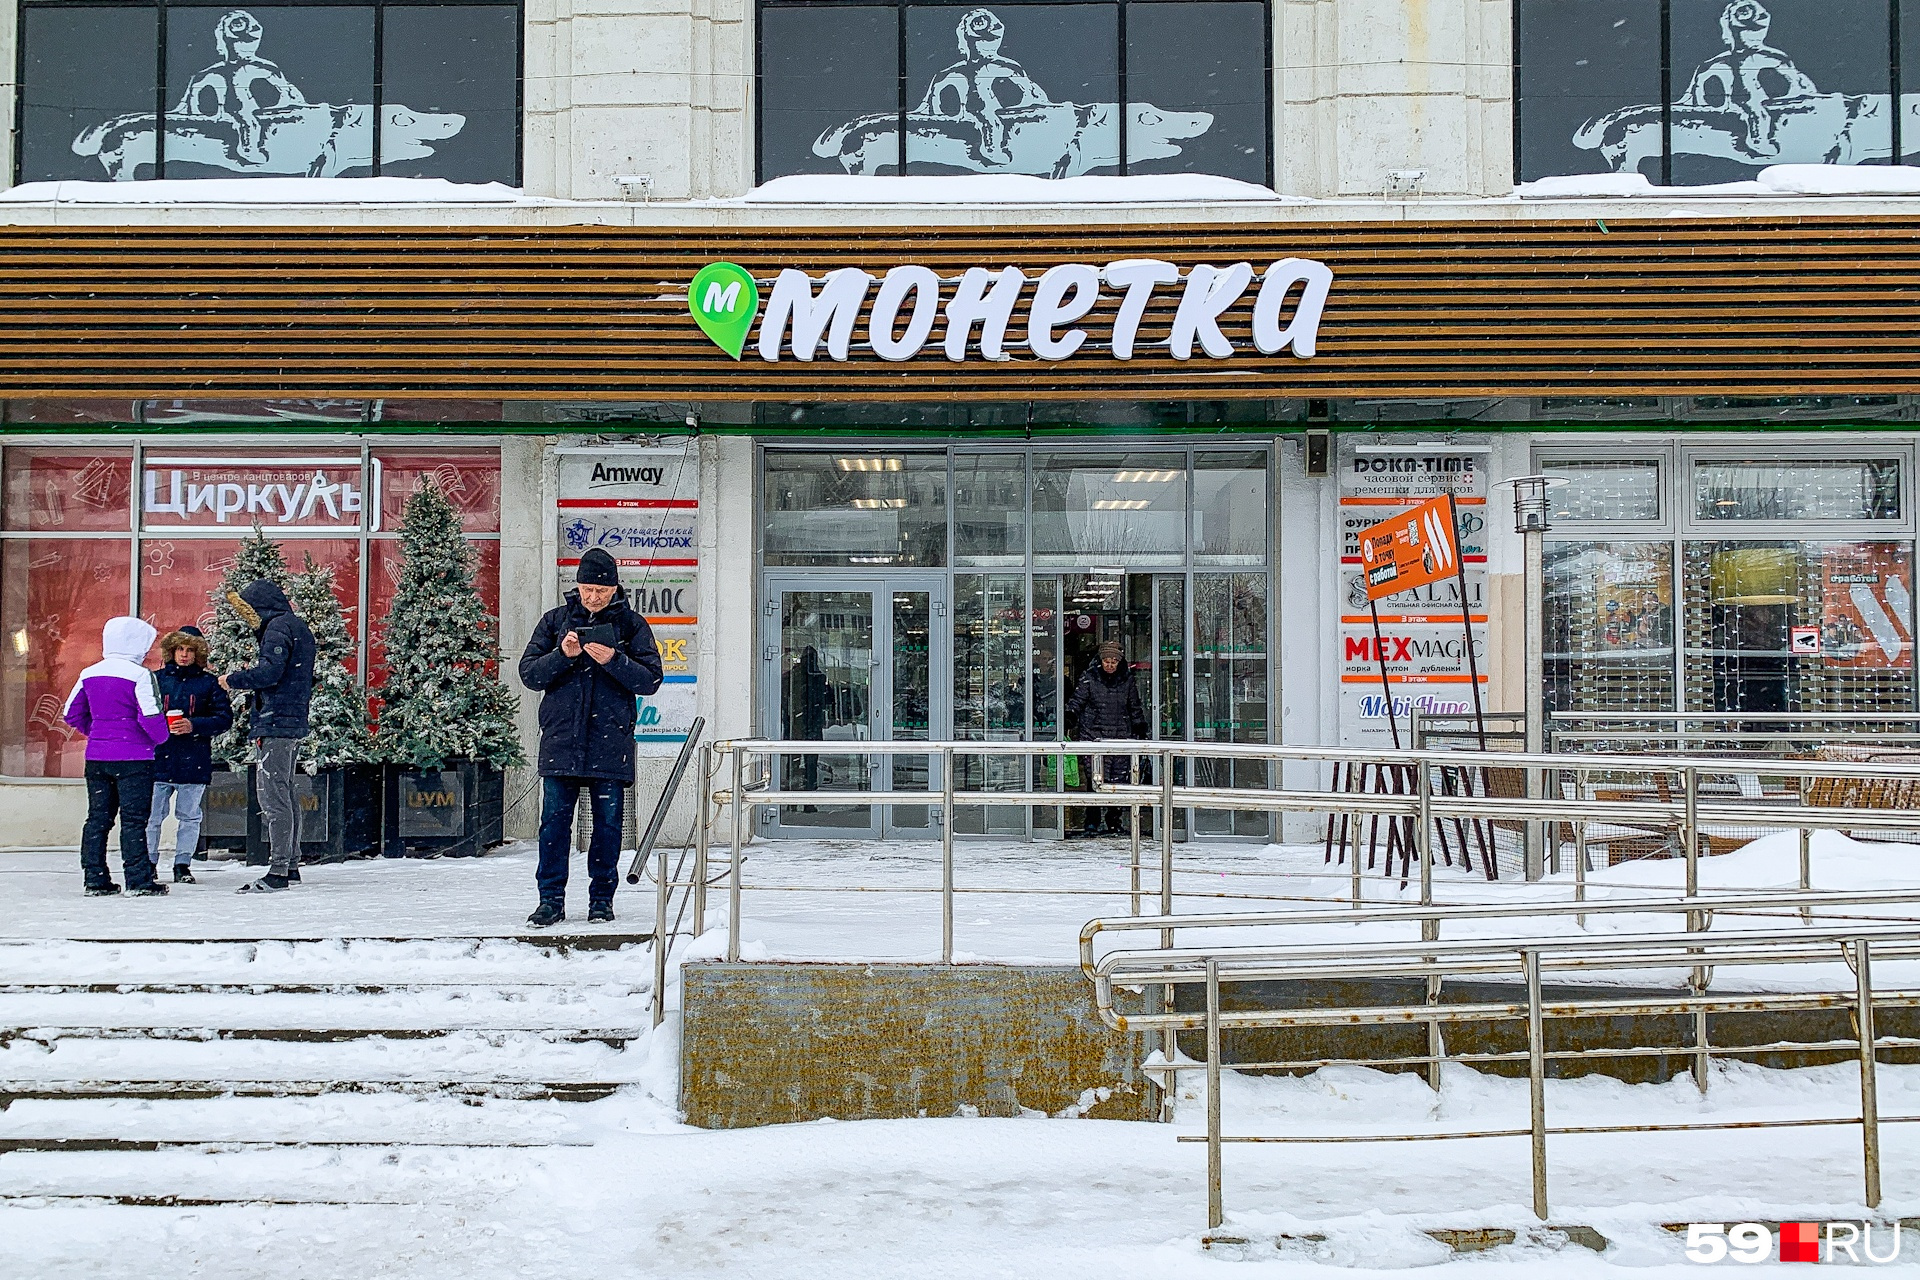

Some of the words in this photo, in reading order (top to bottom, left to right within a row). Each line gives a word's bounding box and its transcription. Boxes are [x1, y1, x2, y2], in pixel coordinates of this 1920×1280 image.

[204, 473, 241, 483] центре
[590, 462, 664, 486] Amway
[1364, 473, 1414, 483] часовой
[1417, 474, 1460, 485] сервис
[1354, 486, 1410, 496] ремешки
[1413, 486, 1436, 495] для
[1439, 485, 1474, 494] часов
[627, 536, 692, 548] ТРИКОТАЖ
[1373, 562, 1397, 586] работой
[1345, 666, 1371, 674] норка
[1420, 665, 1461, 674] дубленки
[1360, 695, 1411, 718] Mobi
[407, 791, 456, 808] ЦУМ
